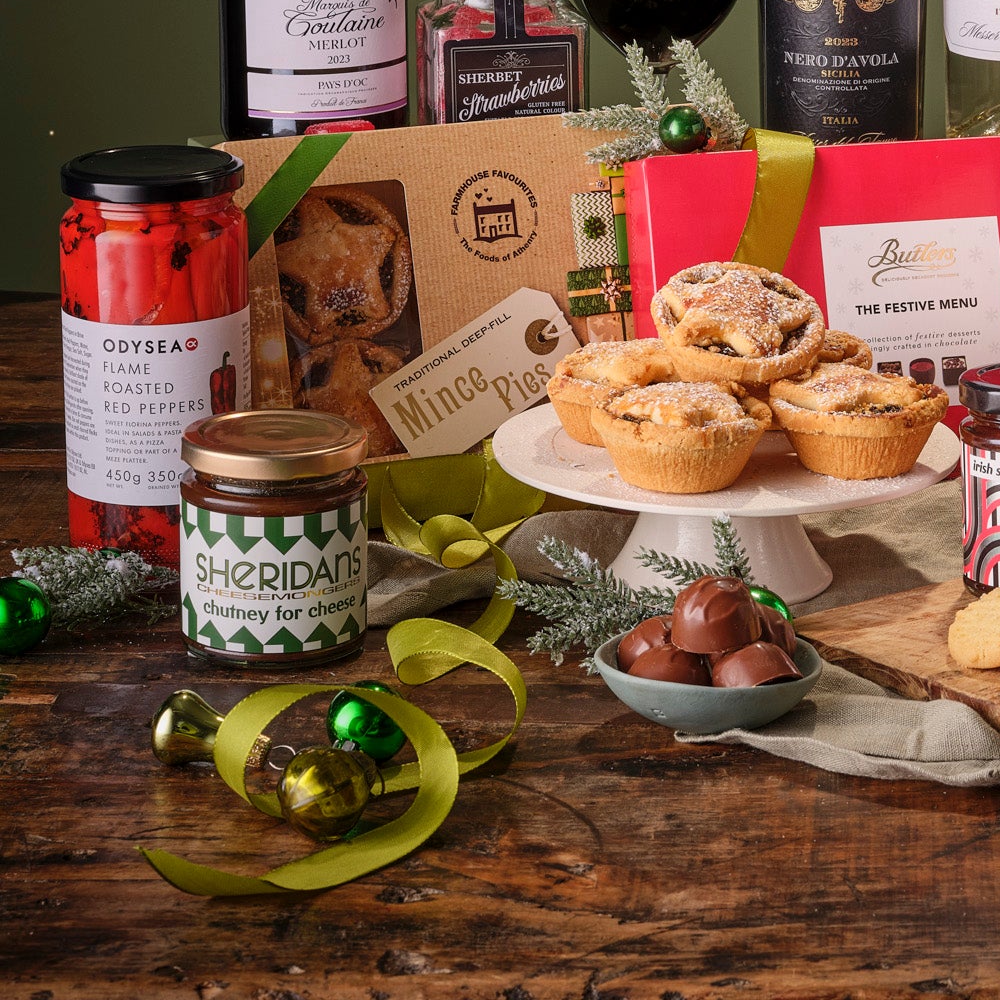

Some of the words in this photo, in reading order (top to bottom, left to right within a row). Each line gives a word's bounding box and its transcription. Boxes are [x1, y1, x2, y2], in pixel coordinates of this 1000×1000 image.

[959, 21, 1000, 41] Messer
[308, 36, 367, 51] MERLOT
[824, 37, 859, 47] 2023
[327, 54, 351, 65] 2023
[783, 51, 828, 67] NERO
[831, 52, 899, 68] D'AVOLA
[458, 71, 523, 84] SHERBET
[792, 76, 851, 85] DENOMINAZIONE
[821, 69, 860, 78] SICILIA
[318, 80, 341, 90] PAYS
[343, 77, 368, 88] D'OC
[458, 73, 566, 121] Strawberries
[822, 116, 859, 125] ITALIA
[450, 170, 490, 216] FARMHOUSE
[492, 169, 538, 209] FAVOURITES
[460, 237, 473, 253] The
[474, 249, 500, 262] Foods
[512, 230, 538, 259] Athenry
[867, 238, 958, 272] Butlers
[855, 304, 881, 316] THE
[885, 300, 935, 314] FESTIVE
[939, 297, 978, 310] MENU
[915, 332, 945, 343] festive
[947, 330, 981, 338] desserts
[934, 338, 978, 347] chocolate
[103, 338, 183, 354] ODYSEA
[393, 346, 461, 392] TRADITIONAL
[461, 312, 512, 348] DEEP-FILL
[103, 361, 151, 375] FLAME
[103, 381, 174, 395] ROASTED
[104, 400, 131, 415] RED
[140, 398, 205, 415] PEPPERS
[391, 366, 489, 441] Mince
[490, 362, 551, 413] Pies
[105, 447, 132, 455] TOPPING
[973, 459, 993, 476] irish
[106, 469, 141, 485] 450g
[197, 577, 361, 601] CHEESEMONGERS
[203, 599, 269, 625] chutney
[276, 605, 303, 621] for
[308, 595, 356, 619] cheese
